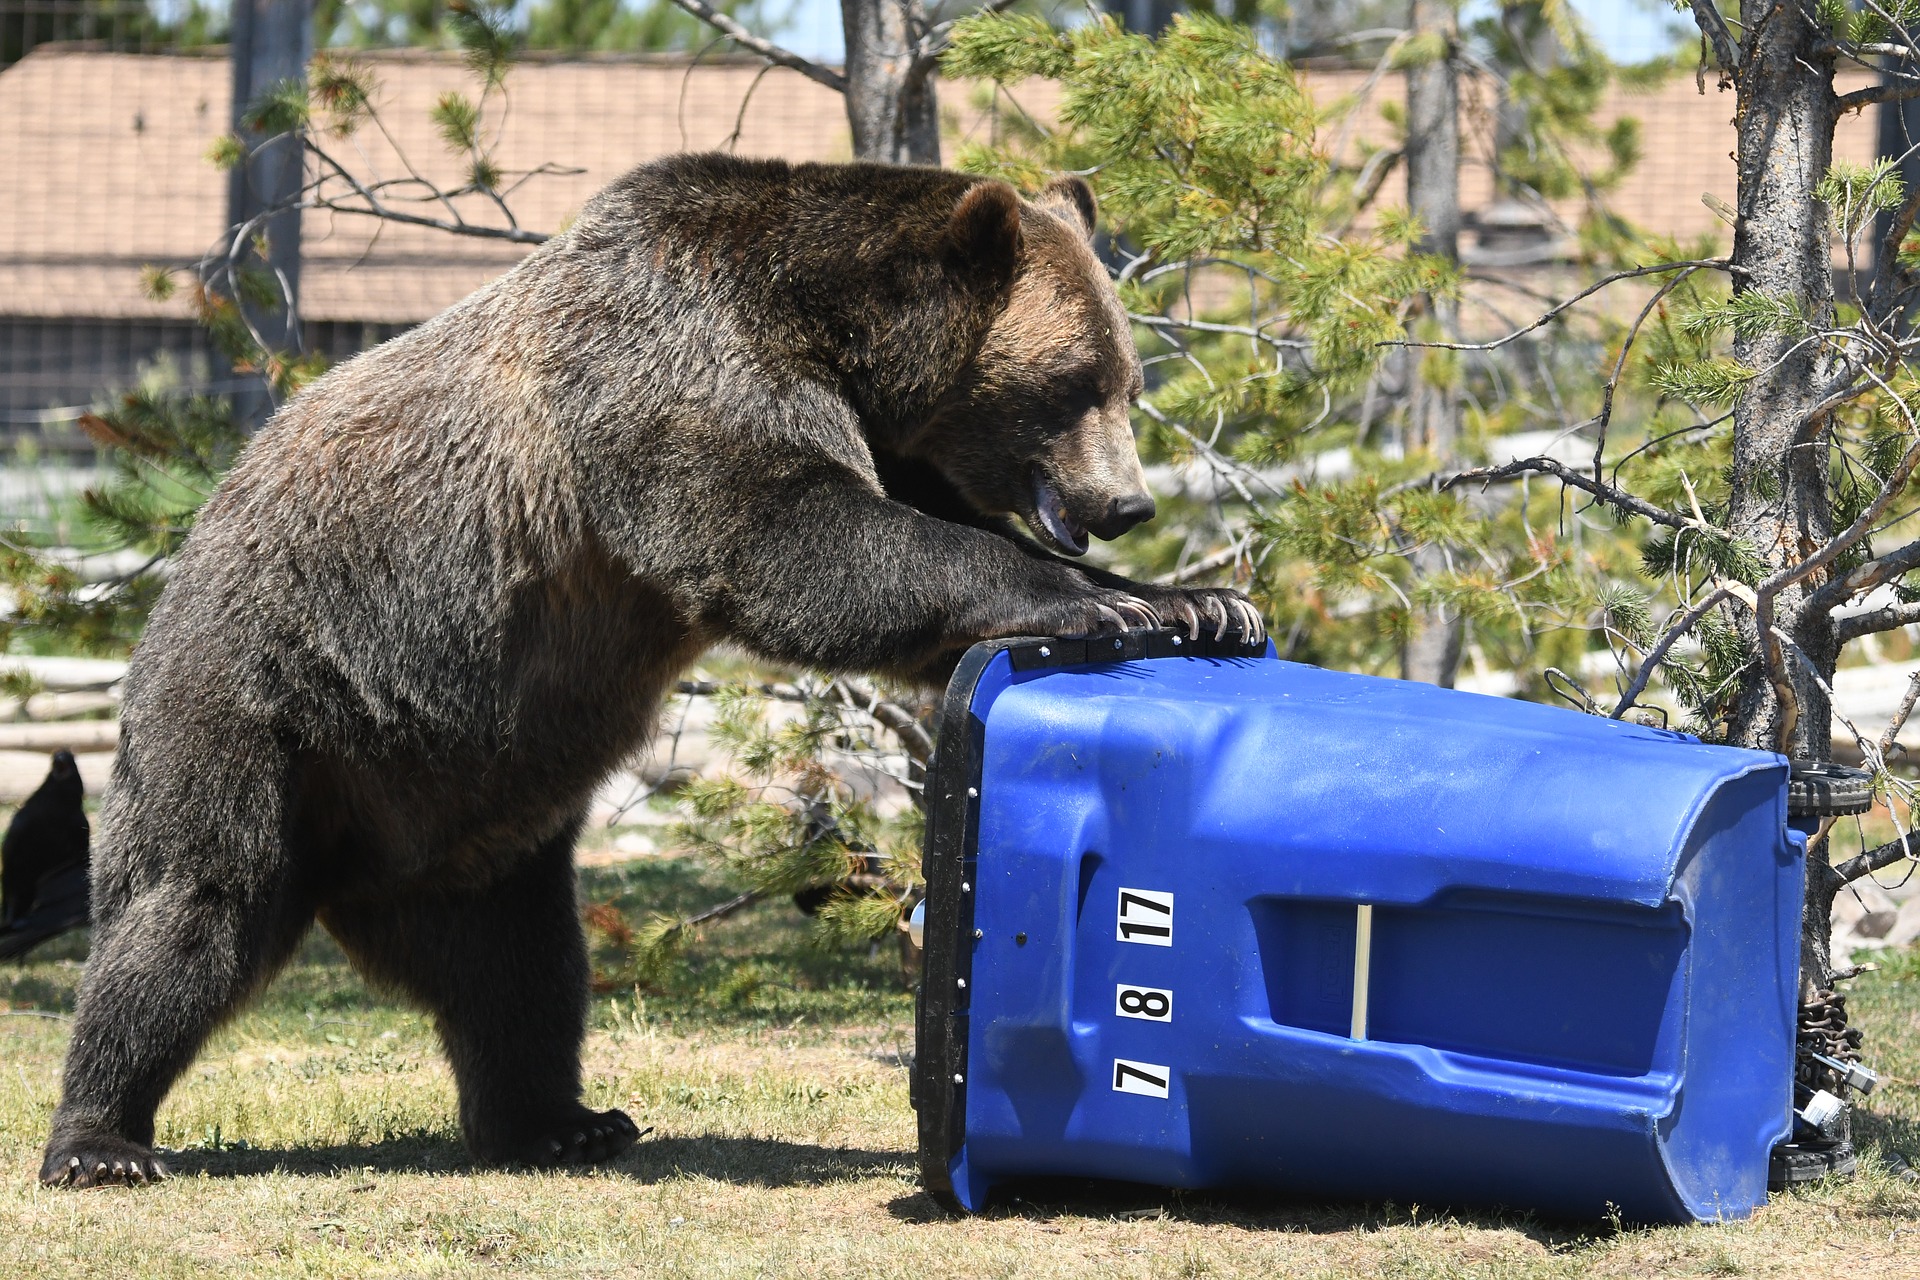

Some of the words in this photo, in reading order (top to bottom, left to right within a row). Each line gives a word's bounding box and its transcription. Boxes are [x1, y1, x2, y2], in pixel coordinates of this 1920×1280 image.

[1119, 891, 1171, 939] 17
[1119, 989, 1170, 1018] 8
[1115, 1062, 1167, 1089] 7
